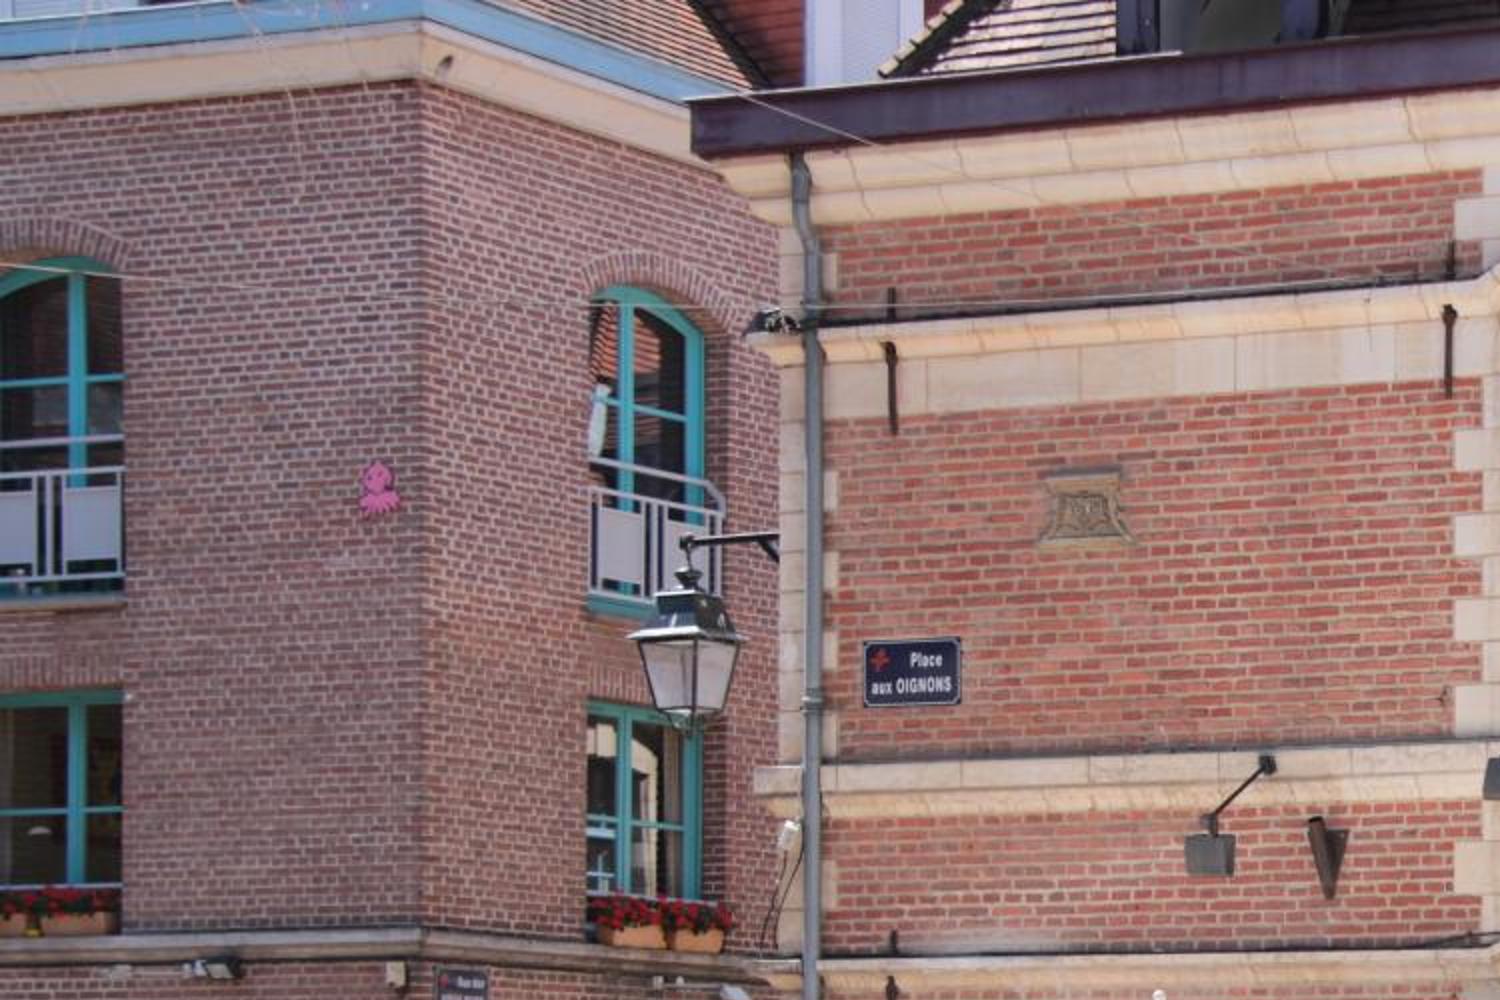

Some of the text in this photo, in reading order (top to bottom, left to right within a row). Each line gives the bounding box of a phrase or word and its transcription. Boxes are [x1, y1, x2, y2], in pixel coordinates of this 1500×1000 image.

[910, 652, 943, 668] Place
[871, 675, 952, 695] aux OIGNONS
